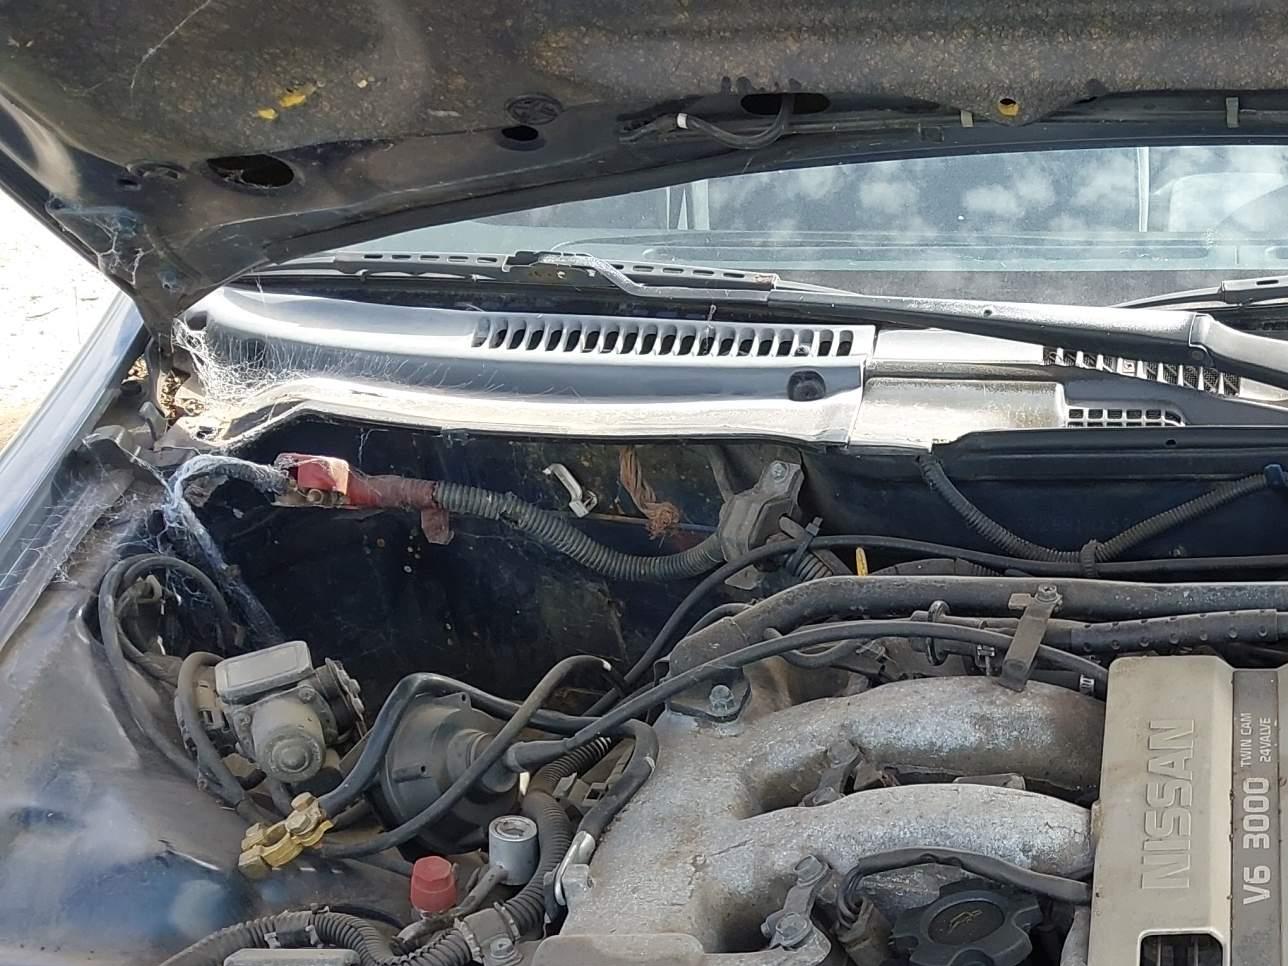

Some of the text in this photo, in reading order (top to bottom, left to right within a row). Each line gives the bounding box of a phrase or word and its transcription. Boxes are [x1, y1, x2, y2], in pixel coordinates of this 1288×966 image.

[1240, 712, 1252, 767] TWIN CAM
[1259, 717, 1272, 763] 24VALVE
[1141, 719, 1195, 889] NISSAN
[1243, 777, 1271, 905] V6 3000
